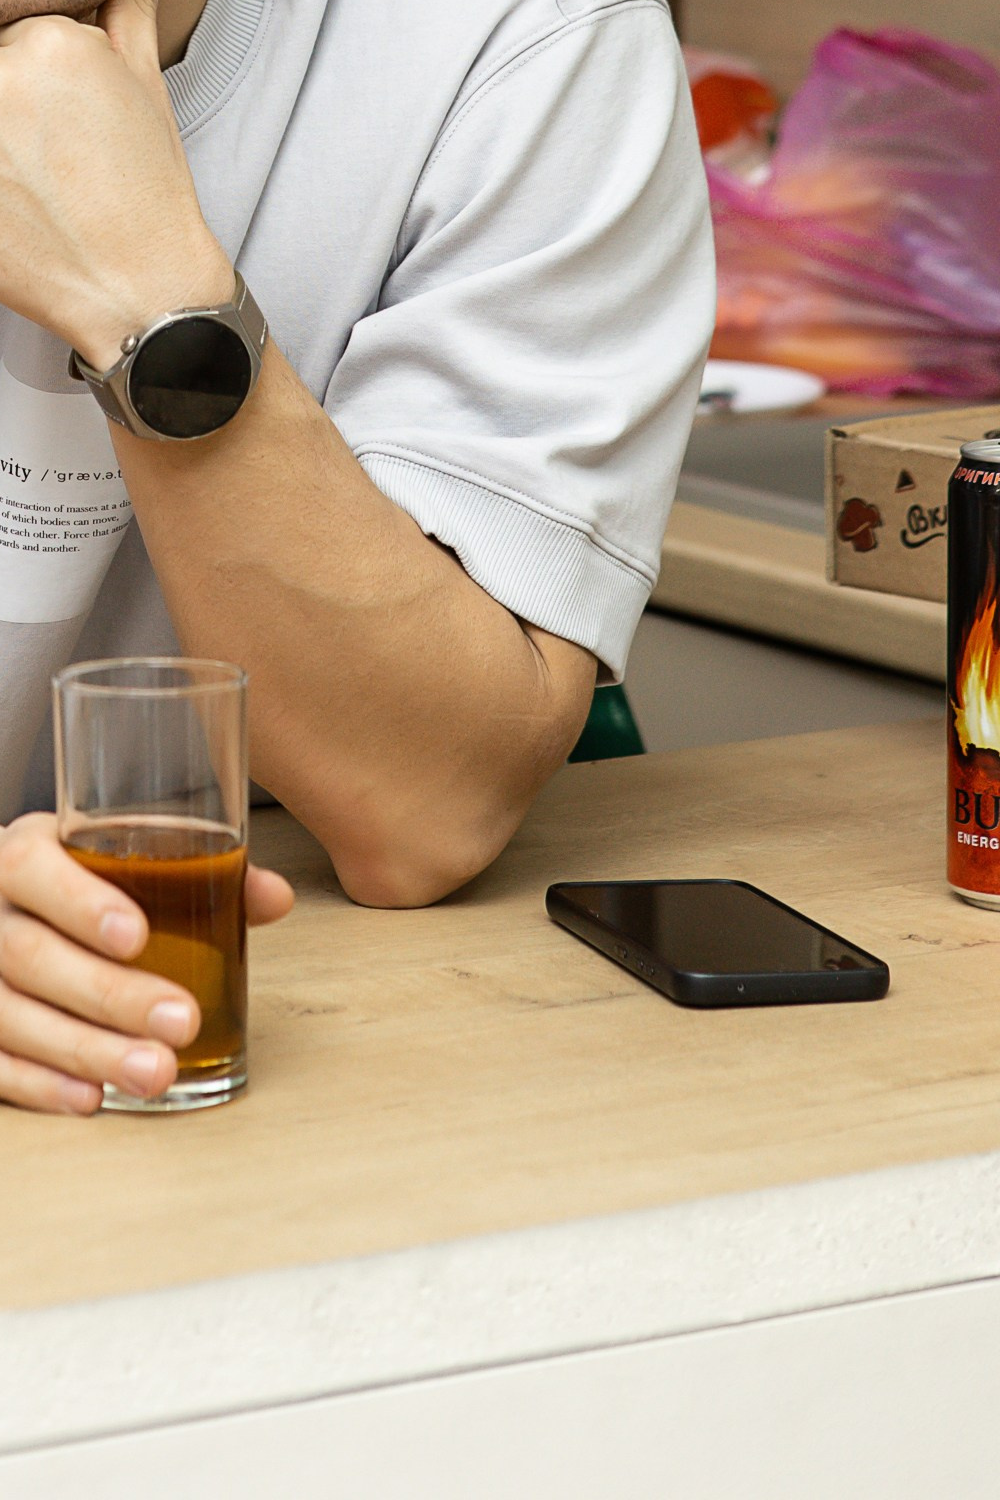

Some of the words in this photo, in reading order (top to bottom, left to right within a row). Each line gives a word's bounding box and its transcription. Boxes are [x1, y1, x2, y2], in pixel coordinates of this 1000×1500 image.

[5, 496, 51, 513] interaction
[53, 504, 65, 513] of
[1, 510, 10, 519] of
[12, 514, 37, 525] which
[40, 516, 71, 526] bodies
[10, 528, 30, 538] each
[33, 530, 60, 539] other.
[63, 531, 90, 539] Force
[92, 529, 109, 537] that
[22, 543, 39, 552] and
[42, 544, 80, 553] another.
[954, 787, 1000, 831] BU
[957, 831, 1000, 850] ENERG
